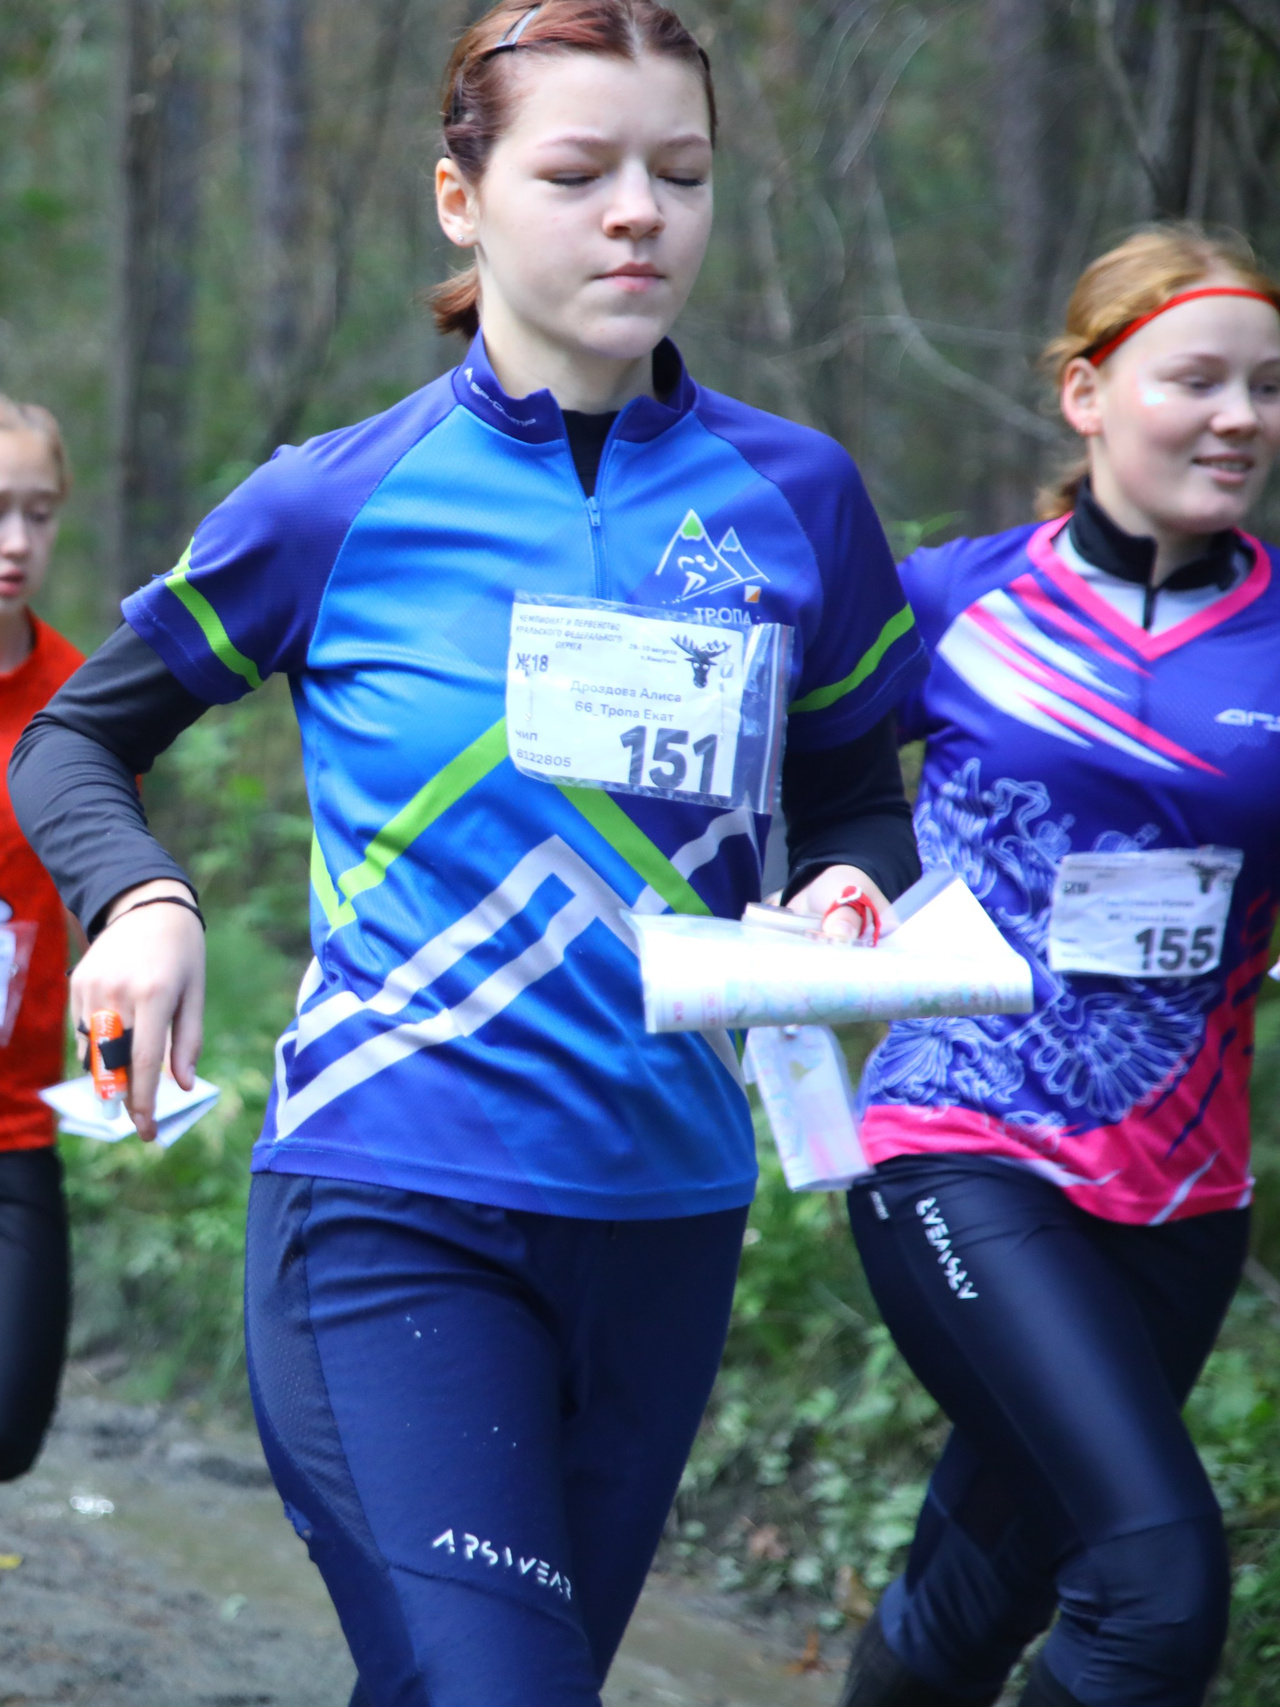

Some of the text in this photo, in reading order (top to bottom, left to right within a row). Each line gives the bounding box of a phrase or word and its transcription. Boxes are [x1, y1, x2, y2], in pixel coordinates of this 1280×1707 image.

[519, 614, 564, 627] ЧЕМПИОНАТ
[574, 618, 621, 632] ПЕРВЕНСТВО
[693, 606, 753, 626] ТРОПА
[515, 652, 549, 676] Ж18
[570, 680, 682, 703] Дроздова Алиса
[643, 708, 675, 722] Екат
[516, 748, 572, 768] 8122805
[620, 725, 718, 793] 151
[1135, 925, 1216, 971] 155
